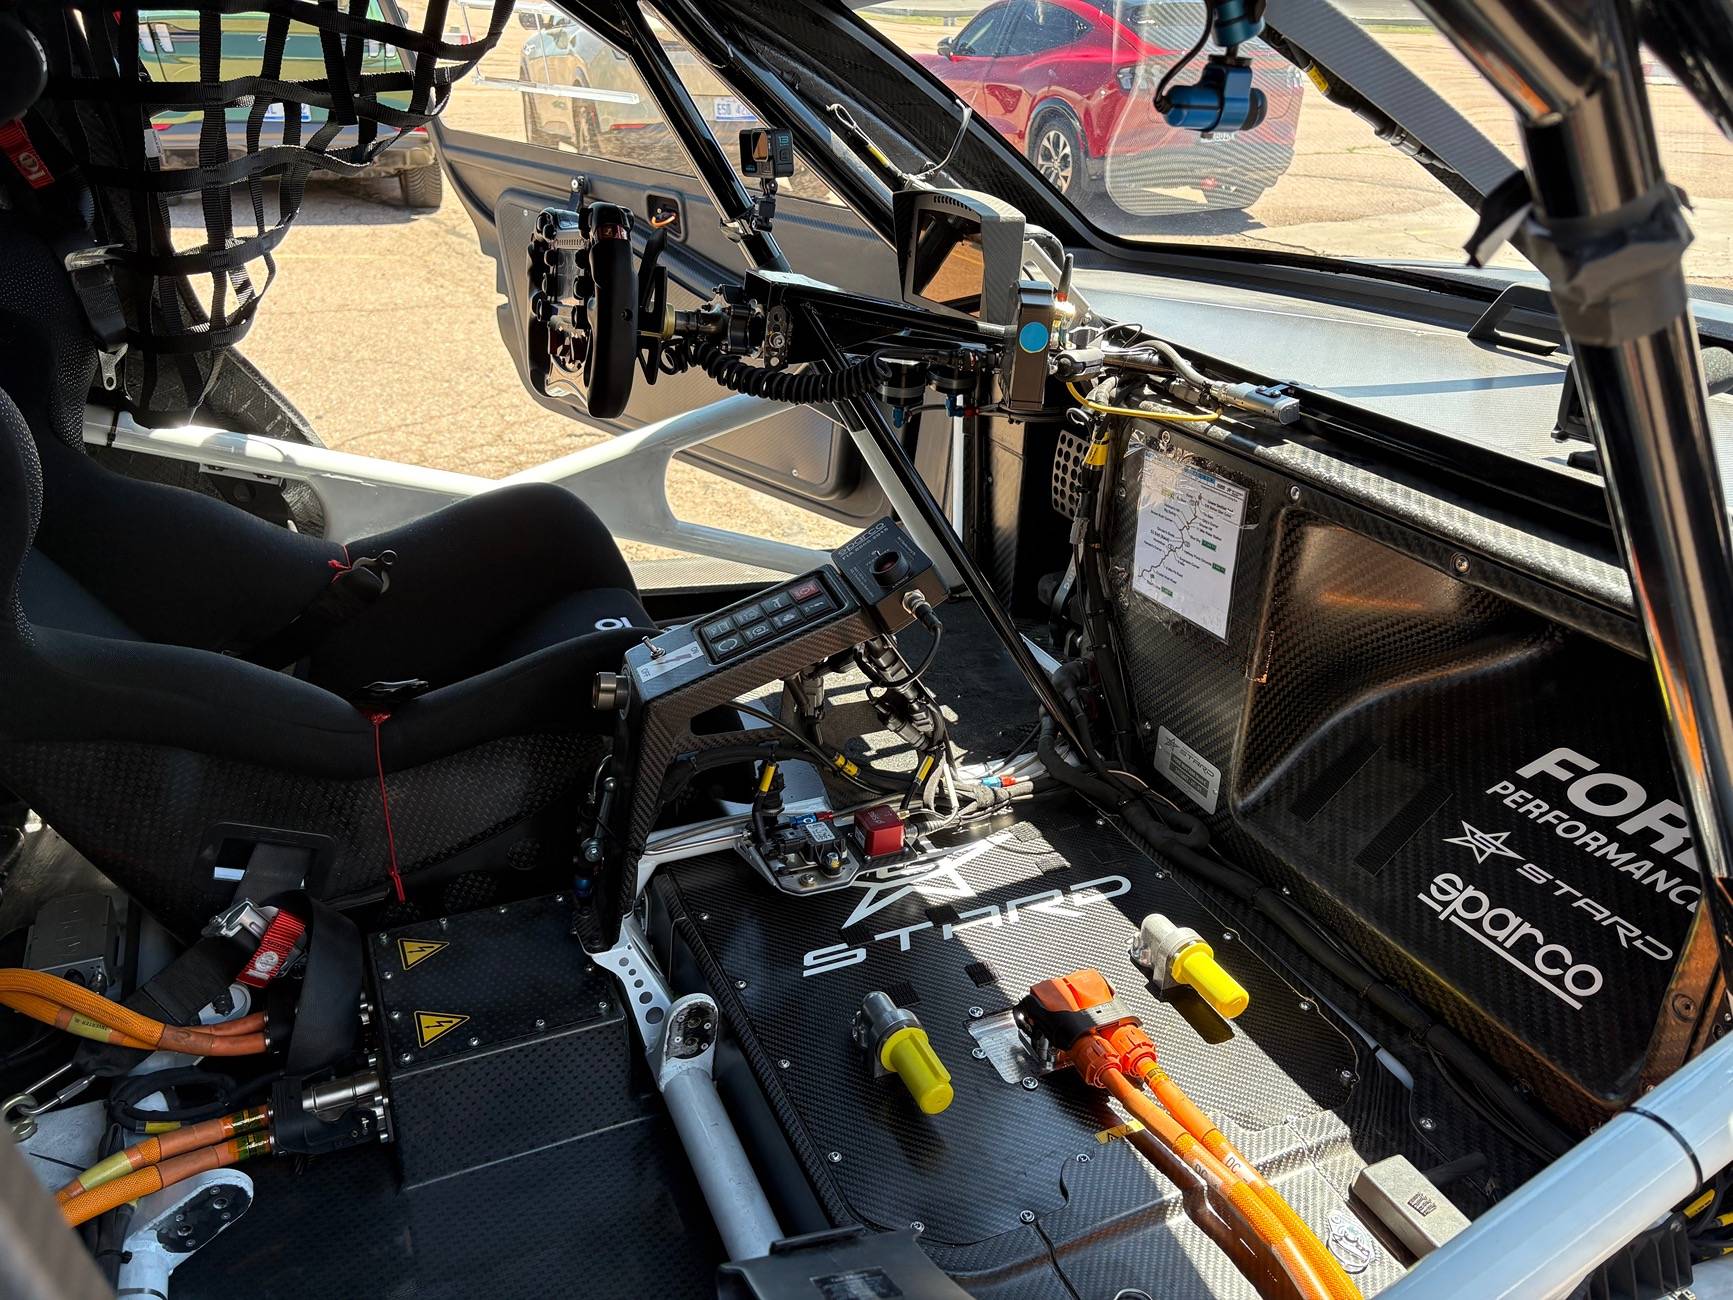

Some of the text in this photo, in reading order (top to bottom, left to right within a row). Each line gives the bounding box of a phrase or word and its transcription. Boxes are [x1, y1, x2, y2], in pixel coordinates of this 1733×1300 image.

[1485, 780, 1702, 913] PERFORMANC
[1429, 873, 1603, 998] sparco
[1516, 863, 1673, 961] STARD
[1226, 1156, 1241, 1174] DC
